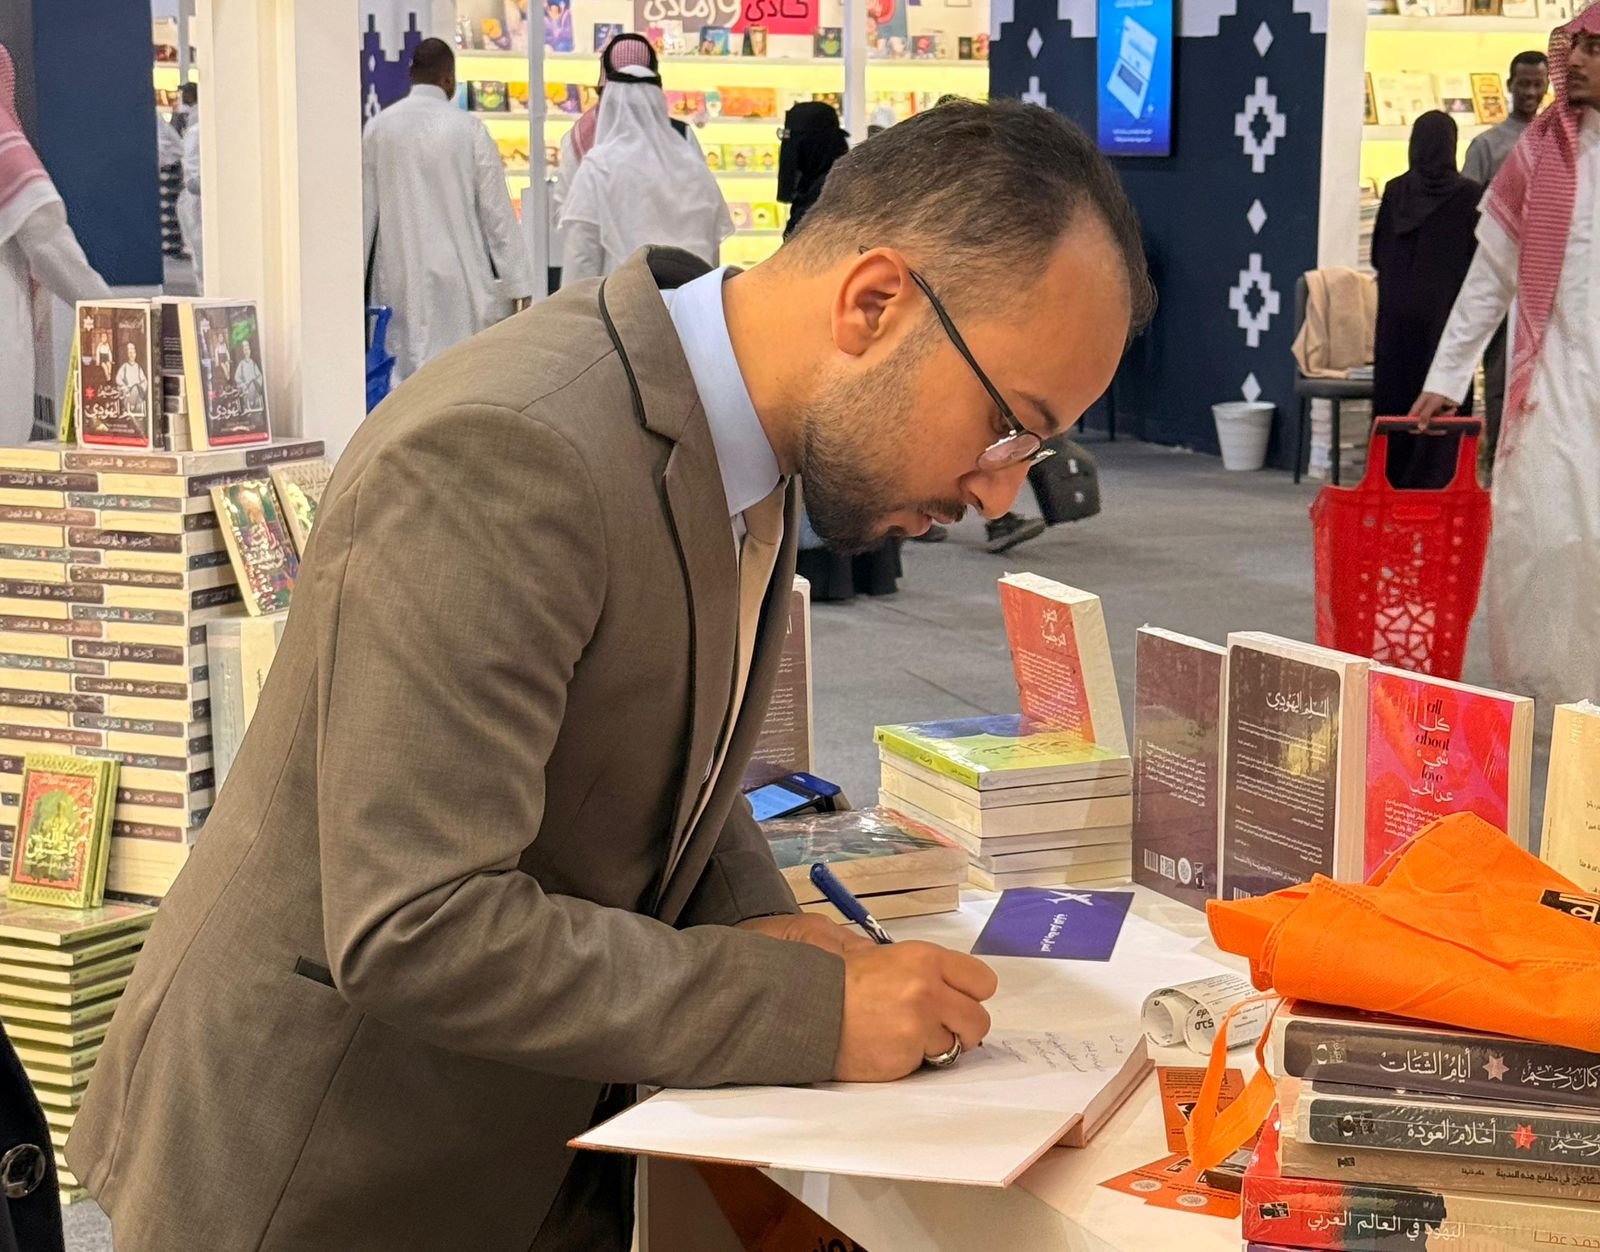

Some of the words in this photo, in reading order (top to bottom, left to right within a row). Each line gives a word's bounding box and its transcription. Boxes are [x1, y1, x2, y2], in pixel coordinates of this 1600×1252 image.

[1265, 690, 1302, 713] اليهودي
[1426, 699, 1442, 715] all
[1418, 713, 1451, 732] كل
[1415, 730, 1450, 751] about
[1416, 750, 1449, 770] شيء
[1421, 765, 1443, 782] love
[1409, 781, 1434, 799] الحب
[1434, 791, 1454, 803] عن
[1307, 1211, 1351, 1232] العربي
[1357, 1214, 1401, 1235] العالم
[1405, 1218, 1420, 1240] في
[1424, 1221, 1466, 1240] اليهود
